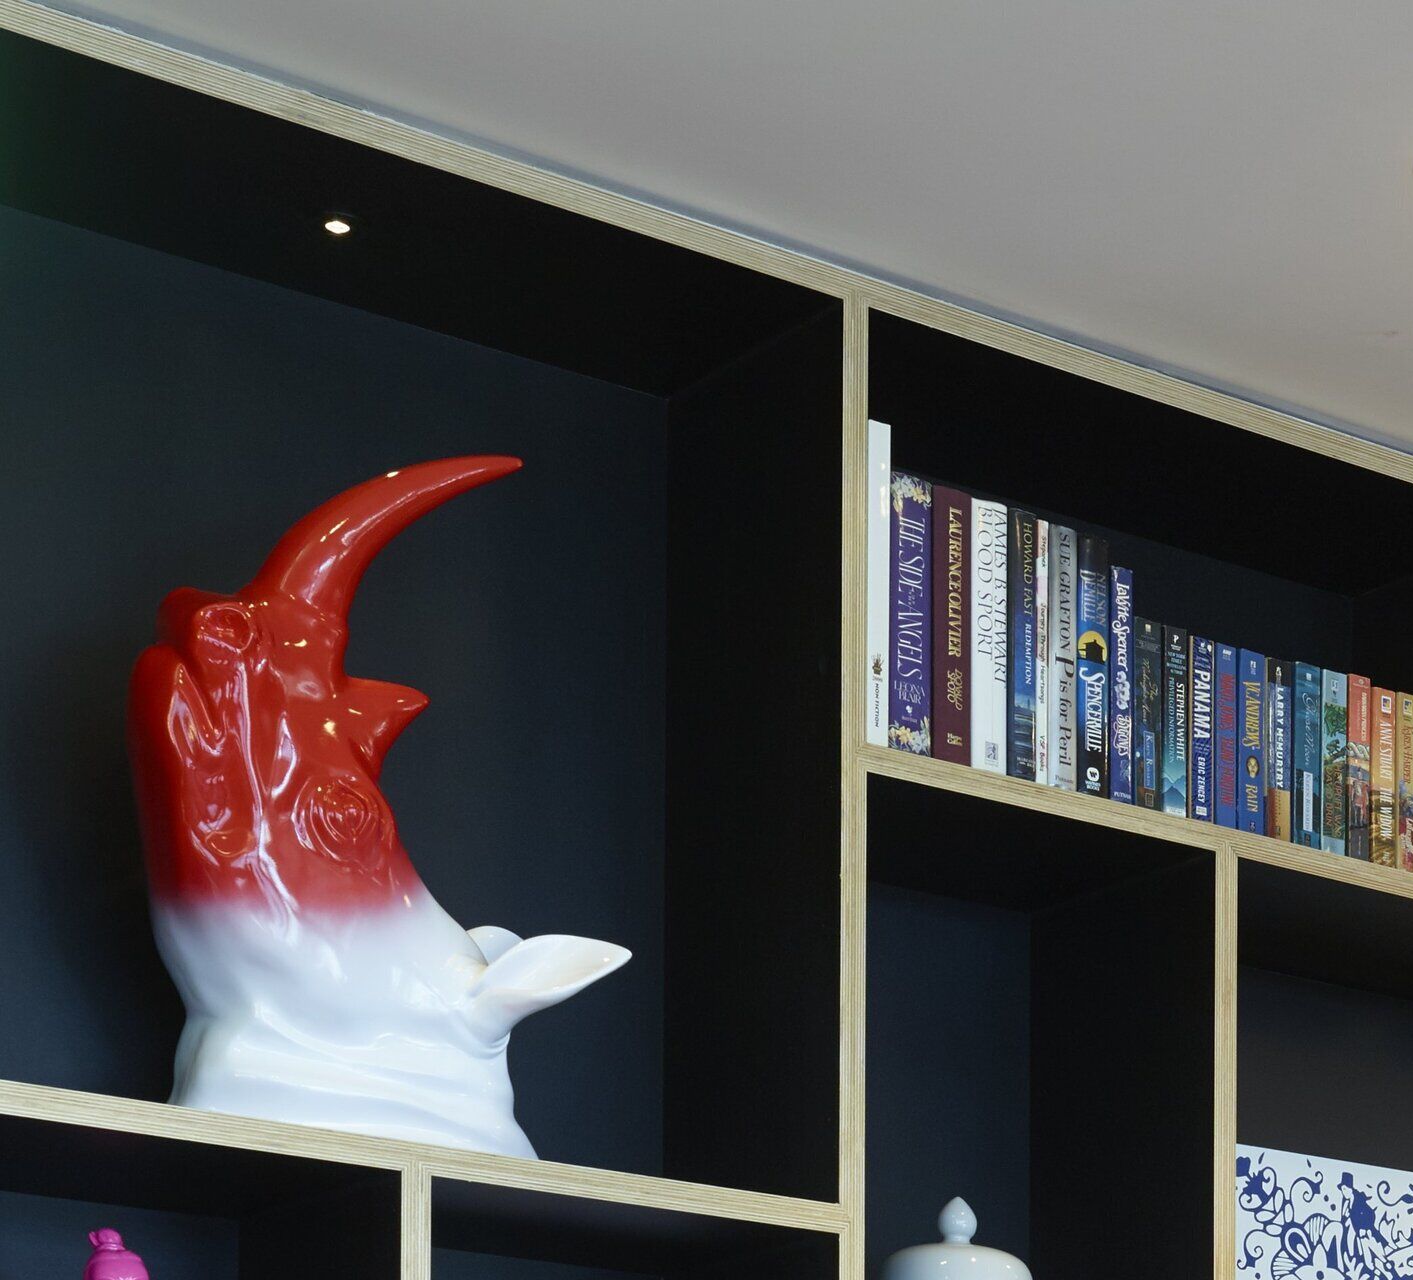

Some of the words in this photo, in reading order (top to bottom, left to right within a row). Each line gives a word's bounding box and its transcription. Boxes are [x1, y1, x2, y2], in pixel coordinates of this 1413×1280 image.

[898, 516, 926, 550] THE
[948, 507, 963, 593] LAURENCE
[977, 505, 993, 585] BLOOD
[994, 507, 1008, 569] JAMES
[1023, 522, 1035, 585] HOWARD
[1060, 532, 1071, 564] SUE
[898, 550, 926, 592] SIDE
[994, 577, 1007, 593] B.
[1023, 587, 1035, 617] FAST
[1060, 571, 1071, 651] GRAFTON
[1080, 569, 1098, 623] DEMILLE
[1096, 574, 1108, 627] NELSON
[897, 598, 924, 681] ANGELS
[948, 592, 963, 658] OLIVIER
[977, 590, 993, 661] SPORT
[994, 598, 1008, 687] STEWART
[1112, 621, 1131, 672] Spencer
[1025, 622, 1033, 685] REDEMPTION
[1054, 655, 1076, 682] P
[947, 670, 957, 703] SPOTO
[955, 668, 963, 711] DONALD
[1060, 681, 1071, 694] is
[1168, 677, 1176, 714] PRIVILEGED
[1176, 682, 1186, 725] STEPHEN
[1193, 668, 1212, 740] PANAMA
[1276, 686, 1285, 724] LARRY
[1060, 698, 1072, 721] for
[1079, 667, 1105, 754] SPENCERVILLE
[1059, 723, 1072, 767] Peril
[1168, 715, 1176, 763] INFORMATION
[1176, 727, 1186, 761] WHITE
[1380, 720, 1393, 746] ANNE
[1197, 757, 1207, 775] ERIC
[1275, 727, 1285, 788] McMURTRY
[1380, 745, 1393, 781] STUART
[1197, 775, 1207, 804] ZENCEY
[1245, 784, 1259, 812] RAIN
[1380, 784, 1394, 805] THE
[1380, 805, 1394, 839] WIDOW
